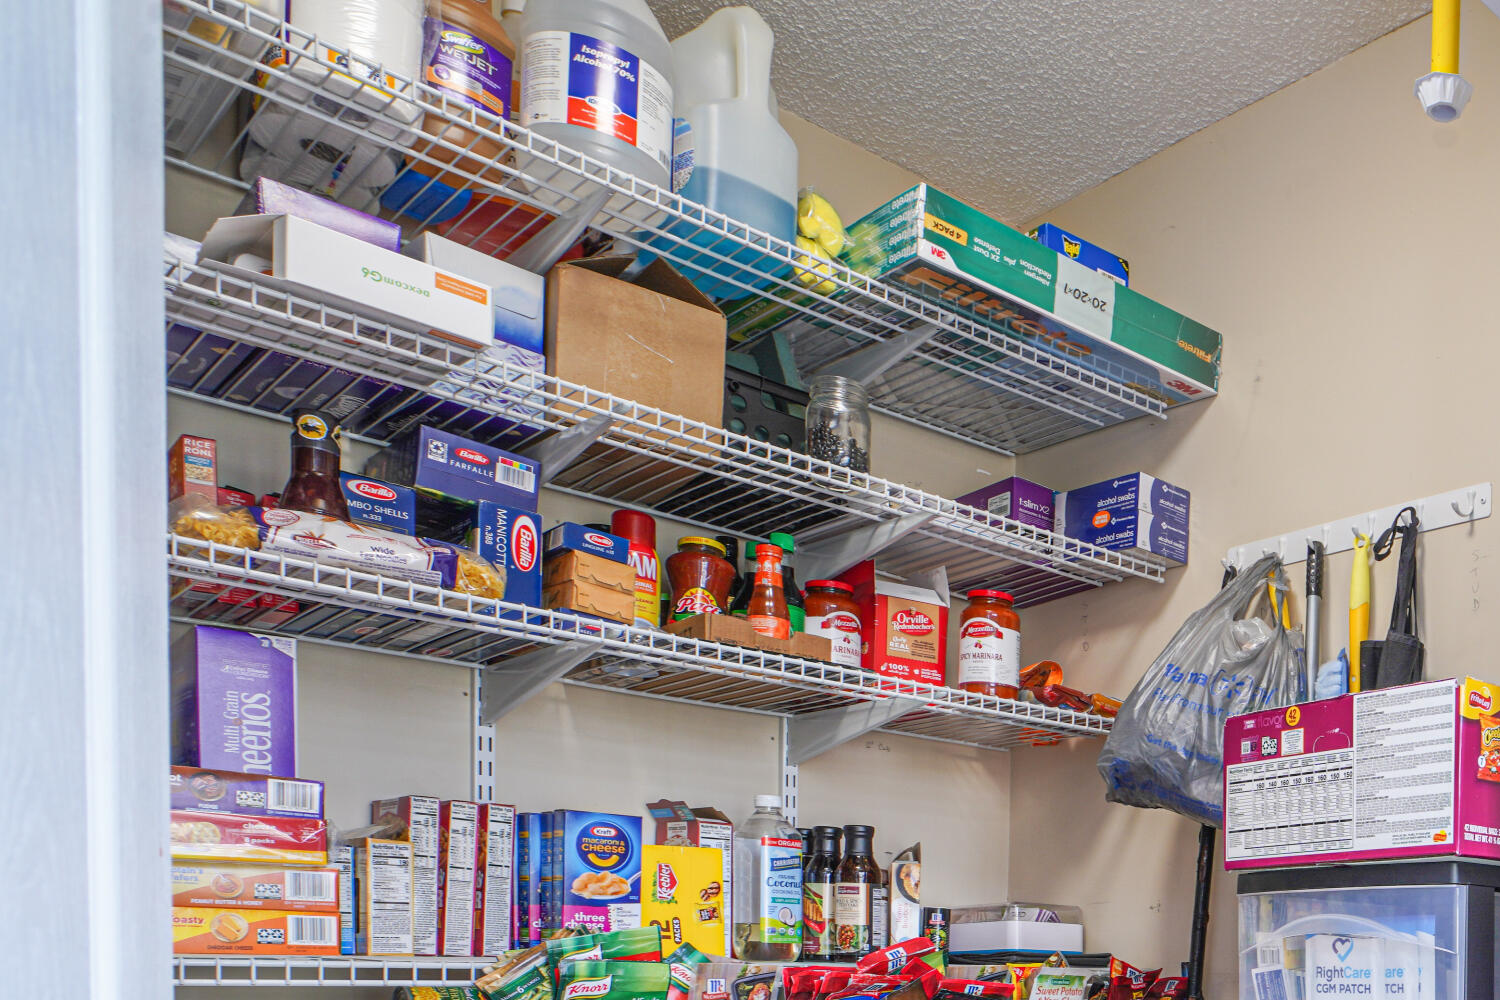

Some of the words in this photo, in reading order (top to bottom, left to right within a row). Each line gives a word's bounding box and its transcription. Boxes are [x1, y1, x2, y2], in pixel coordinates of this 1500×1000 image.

[441, 31, 485, 51] Swiffer
[440, 43, 497, 75] WETJET
[581, 44, 631, 68] Isopropyl
[612, 62, 636, 83] 70%
[932, 220, 955, 238] PACK
[930, 247, 947, 260] 3M
[973, 236, 1001, 256] Defense
[1019, 259, 1053, 281] Reduction
[1023, 269, 1051, 287] Allergen
[1177, 339, 1213, 364] Filtrete
[183, 437, 212, 449] RICE
[455, 448, 490, 465] Barilla
[450, 459, 494, 479] FARFALLE
[356, 481, 397, 500] Barilla
[1040, 502, 1051, 515] X2
[1097, 496, 1116, 508] alcohol
[1117, 492, 1136, 503] swabs
[374, 503, 409, 521] SHELLS
[496, 508, 509, 568] MANICOTTI
[1095, 534, 1116, 545] alcohol
[1116, 529, 1134, 540] swabs
[369, 544, 394, 557] Wide
[518, 526, 538, 571] Barilla
[892, 620, 936, 632] Redenbacher's
[897, 613, 929, 625] Orville
[832, 645, 861, 658] ARINAR
[972, 653, 1003, 661] MARINARA
[888, 663, 909, 671] 100%
[222, 690, 239, 721] Grain
[1287, 709, 1297, 721] 42
[223, 720, 240, 755] Multi
[239, 692, 273, 776] eerios
[595, 827, 612, 836] Kraft
[582, 836, 620, 846] macaroni
[657, 863, 673, 900] Keebler
[573, 911, 606, 923] three
[670, 965, 692, 982] Kno
[1315, 965, 1371, 982] RightCare
[568, 982, 608, 997] Knorr
[1035, 985, 1059, 996] Sweet
[1060, 985, 1083, 996] Potato
[1316, 984, 1337, 994] CGM
[1339, 984, 1372, 994] PATCH
[1384, 984, 1404, 994] TCH
